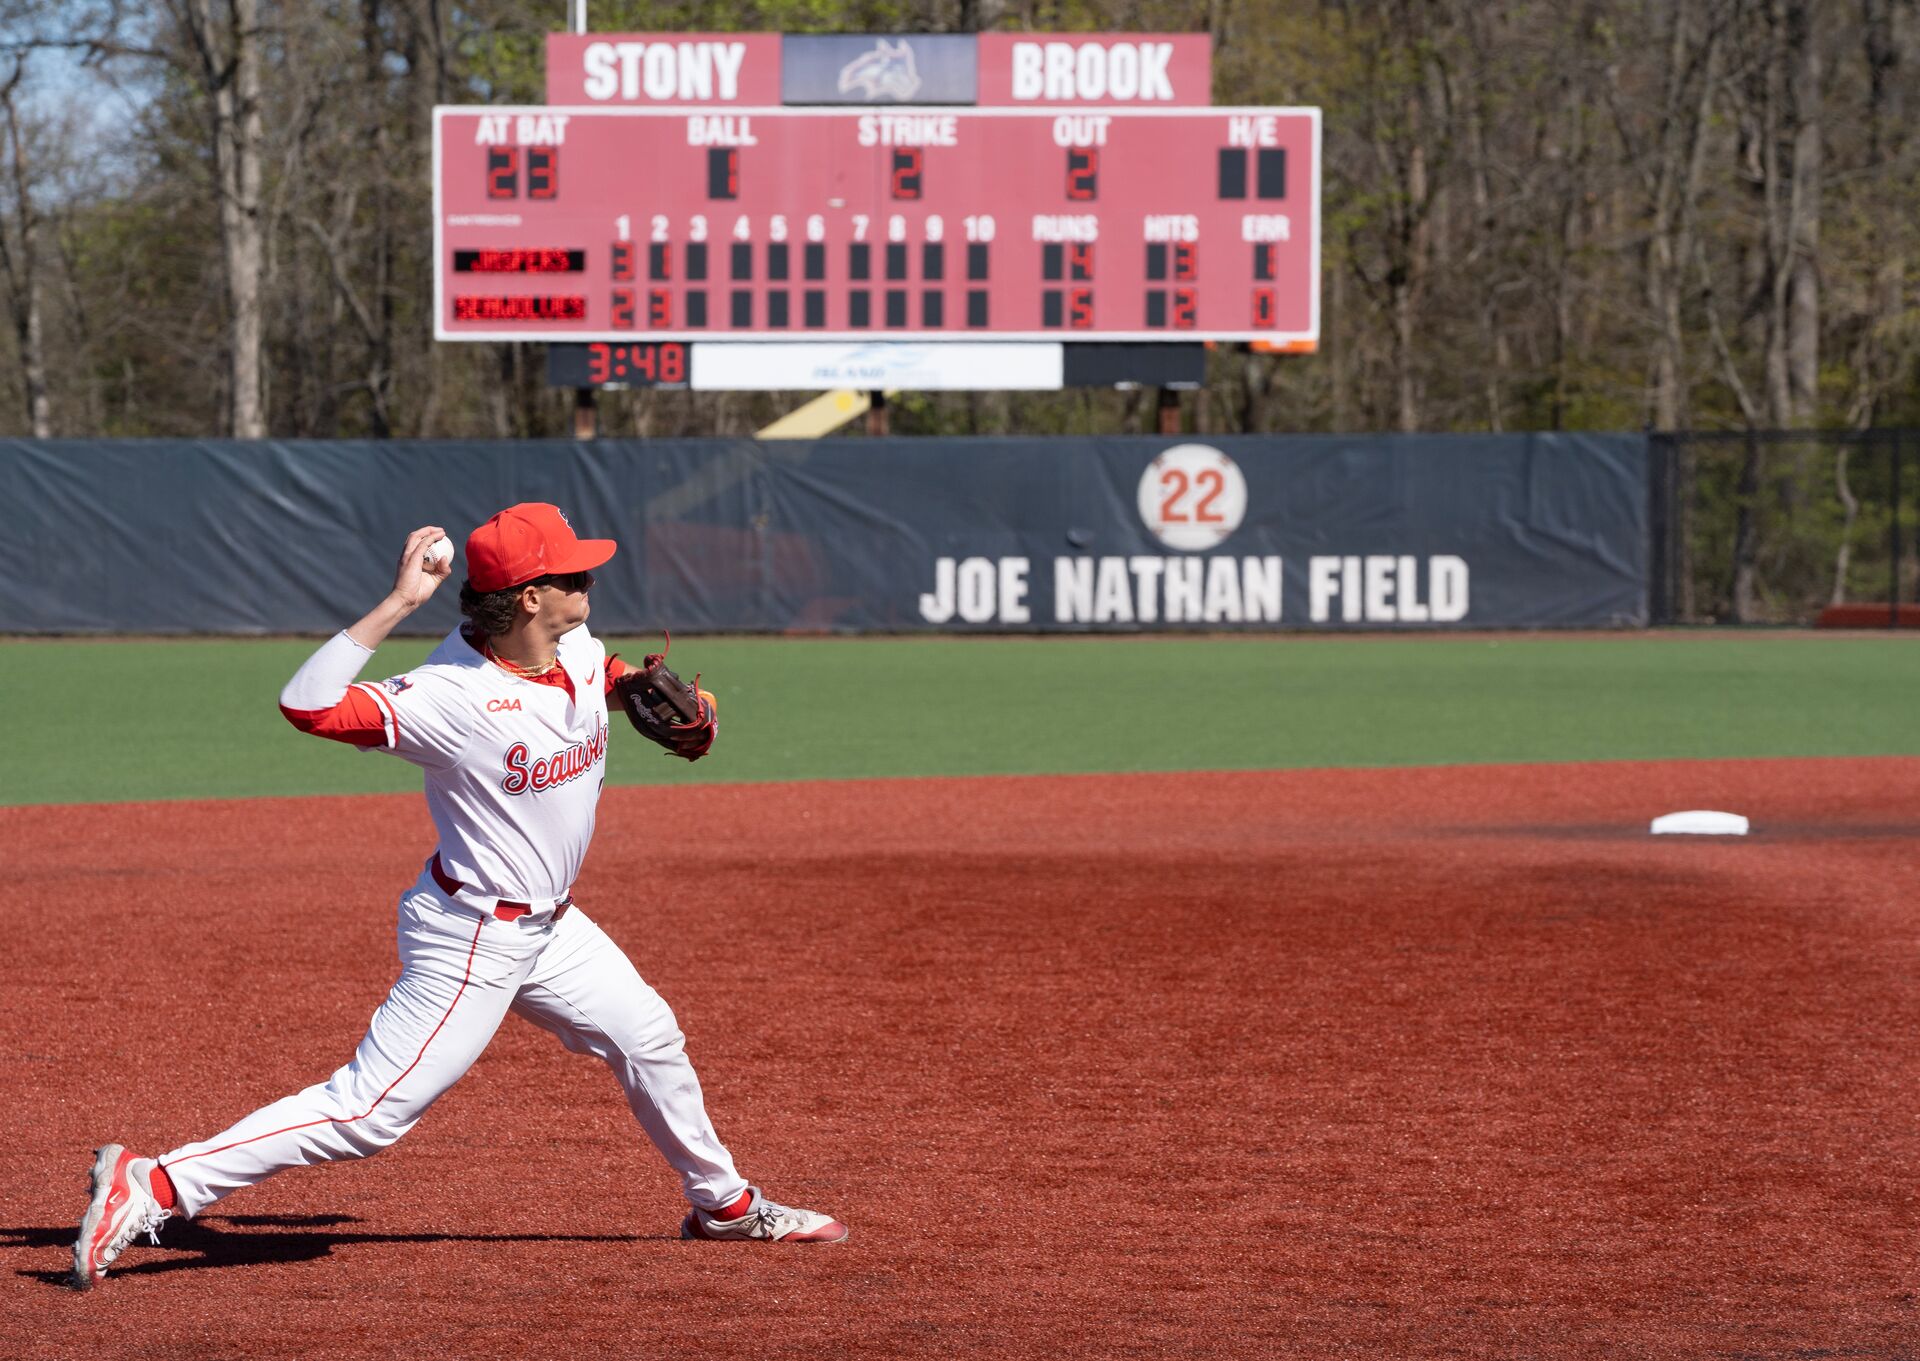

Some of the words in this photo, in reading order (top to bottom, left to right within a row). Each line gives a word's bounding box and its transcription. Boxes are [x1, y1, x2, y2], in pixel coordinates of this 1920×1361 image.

[584, 42, 745, 100] STONY
[1012, 42, 1174, 100] BROOK
[475, 116, 510, 145] AT
[516, 116, 570, 145] BAT
[687, 116, 758, 146] BALL
[858, 116, 958, 147] STRIKE
[1053, 116, 1112, 147] OUT
[1228, 116, 1277, 148] H/E
[488, 147, 557, 198] 23
[728, 148, 737, 196] 1
[892, 147, 921, 199] 2
[1068, 147, 1097, 199] 2
[615, 215, 630, 241] 1
[652, 215, 669, 241] 2
[690, 215, 708, 241] 3
[733, 215, 750, 240] 4
[770, 215, 788, 241] 5
[807, 214, 825, 241] 6
[852, 214, 869, 240] 7
[888, 215, 906, 241] 8
[925, 215, 944, 241] 9
[963, 215, 996, 241] 10
[1032, 214, 1099, 242] RUNS
[1144, 214, 1199, 242] HITS
[1241, 214, 1290, 242] ERR
[613, 243, 634, 280] 3
[663, 245, 671, 279] 1
[1072, 244, 1092, 280] 4
[1176, 244, 1197, 280] 3
[1268, 244, 1276, 279] 1
[612, 290, 634, 328] 2
[651, 290, 671, 328] 3
[1072, 289, 1092, 327] 5
[1175, 289, 1195, 327] 2
[1253, 289, 1275, 327] 0
[588, 342, 685, 384] 3:48
[1159, 469, 1224, 522] 22
[920, 557, 1029, 622] JOE
[1055, 556, 1282, 622] NATHAN
[1310, 556, 1468, 621] FIELD
[486, 698, 523, 713] CAA
